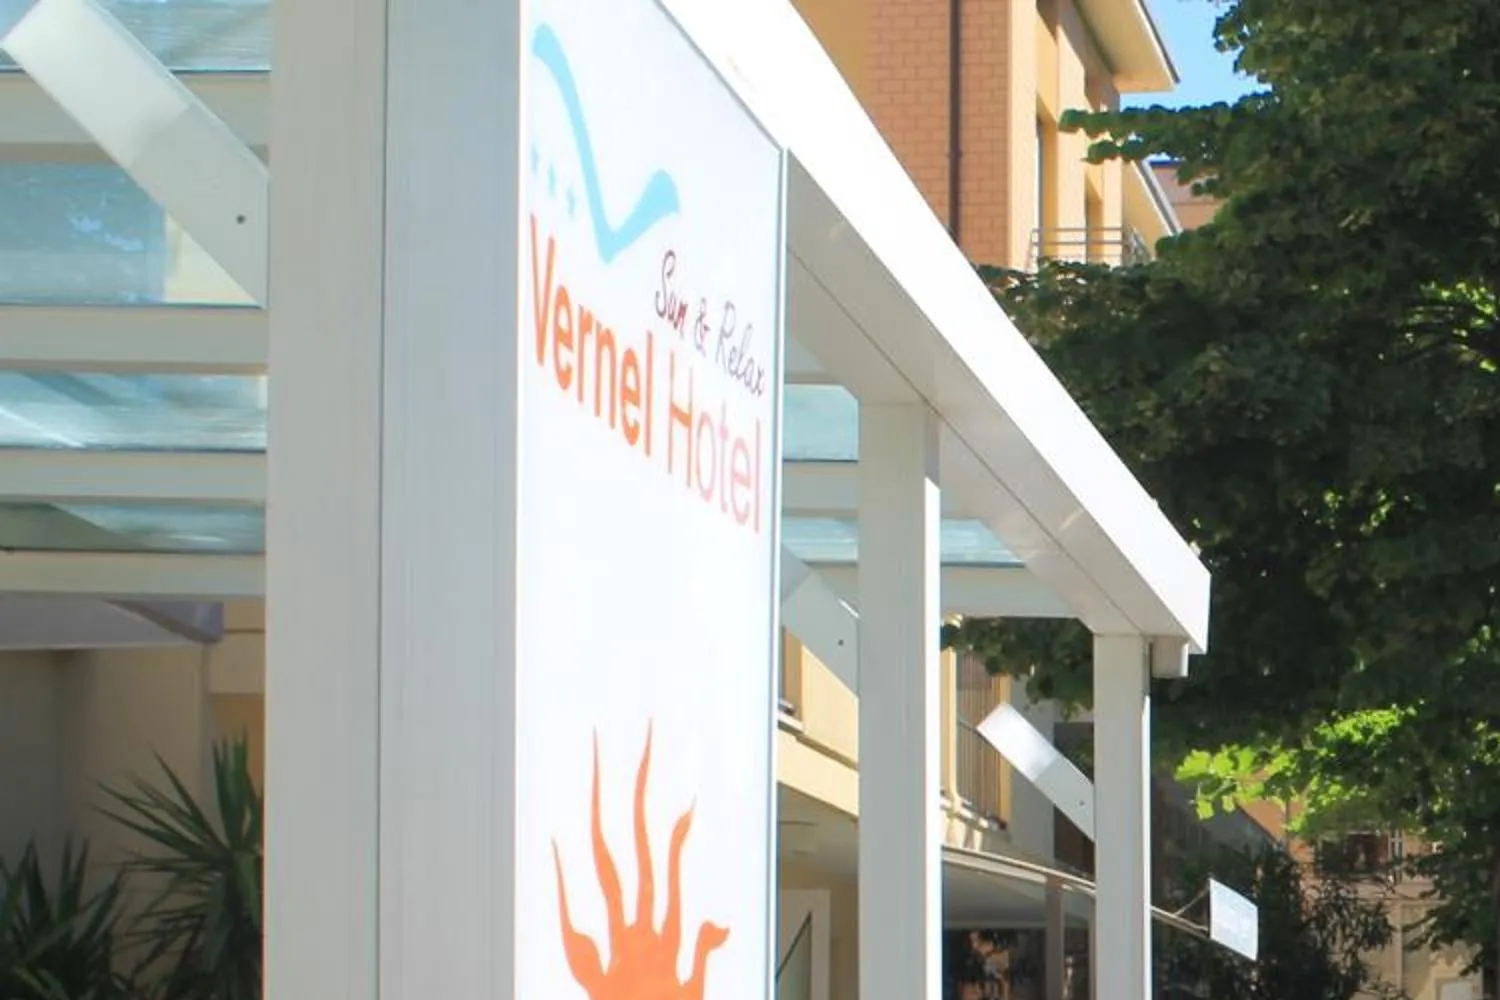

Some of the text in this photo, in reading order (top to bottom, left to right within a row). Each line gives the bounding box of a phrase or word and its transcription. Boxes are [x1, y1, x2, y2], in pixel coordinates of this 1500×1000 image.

[530, 211, 761, 534] Vernel Hotel
[654, 249, 766, 398] Sun & Relax
